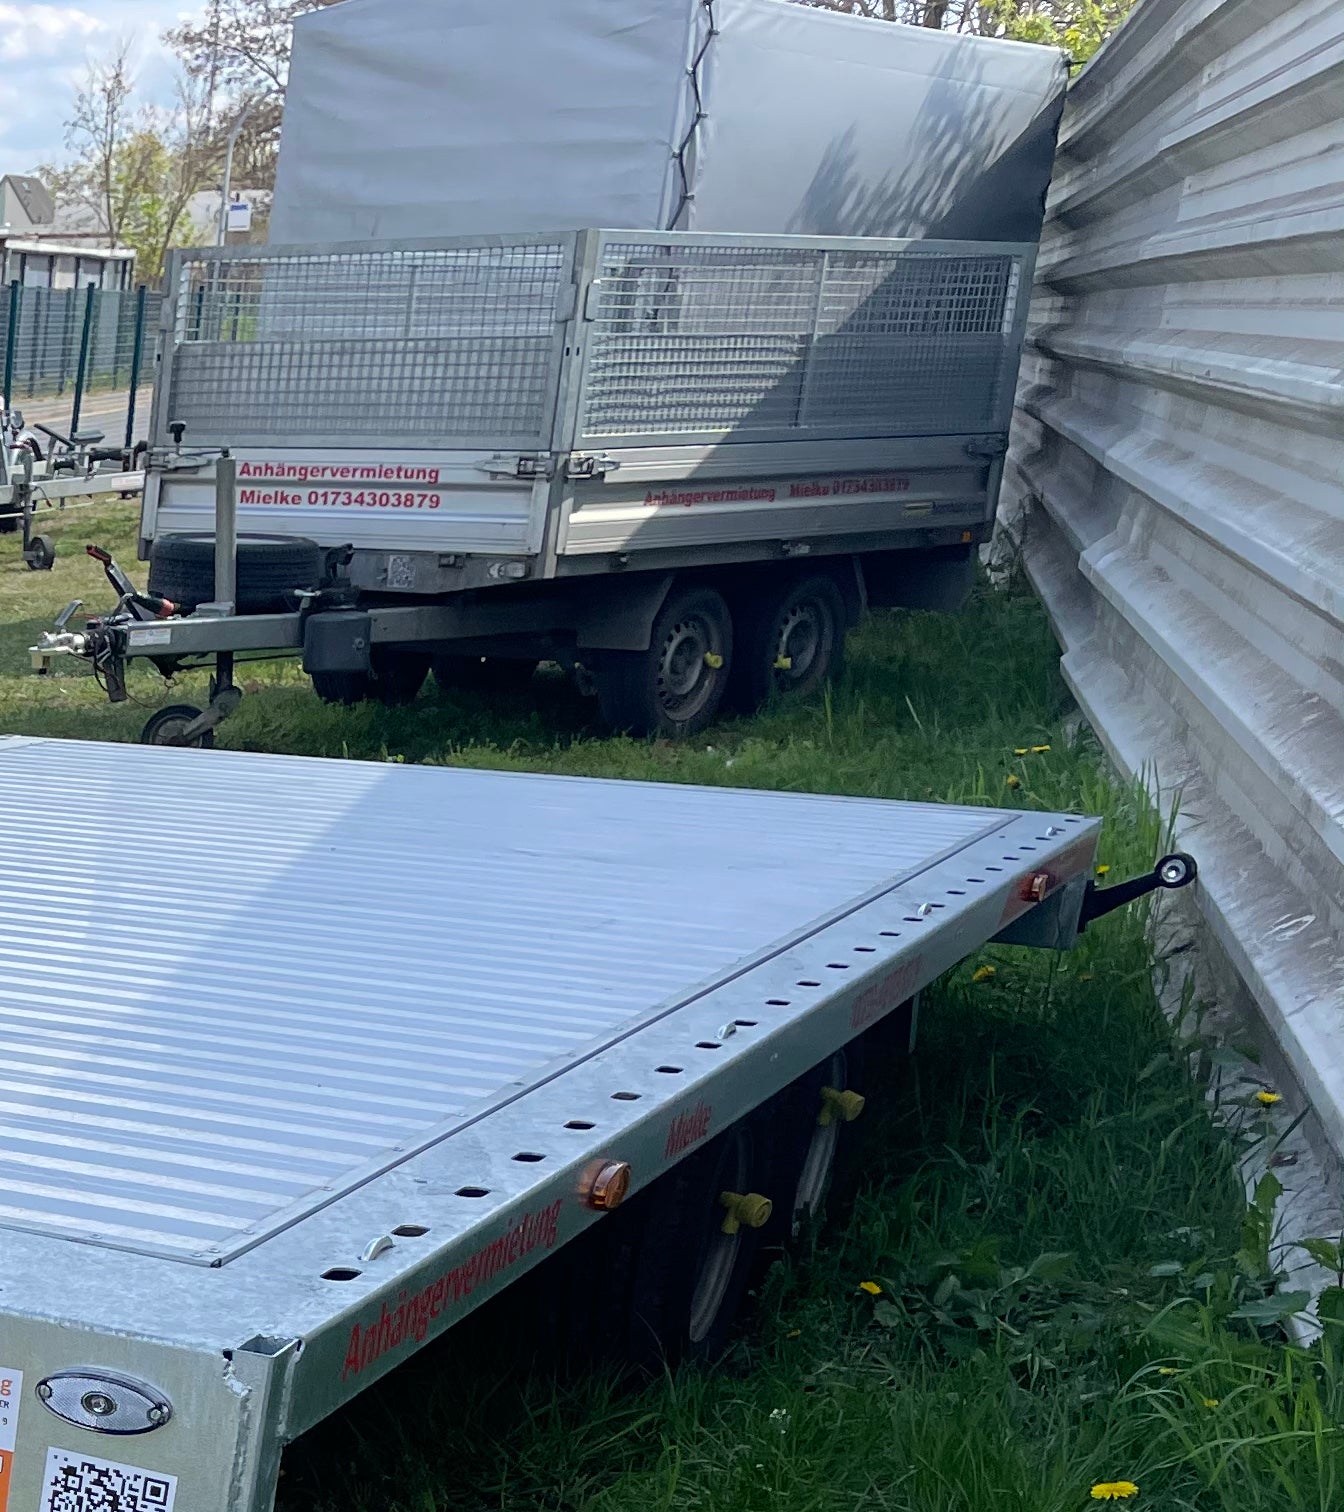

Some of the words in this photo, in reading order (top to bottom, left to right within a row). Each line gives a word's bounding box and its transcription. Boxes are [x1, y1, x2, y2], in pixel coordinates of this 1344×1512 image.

[239, 462, 440, 484] Anhängervermietung
[240, 490, 302, 505] Mielke
[307, 491, 441, 508] 01734303879
[341, 1199, 562, 1383] Anhängervermietung
